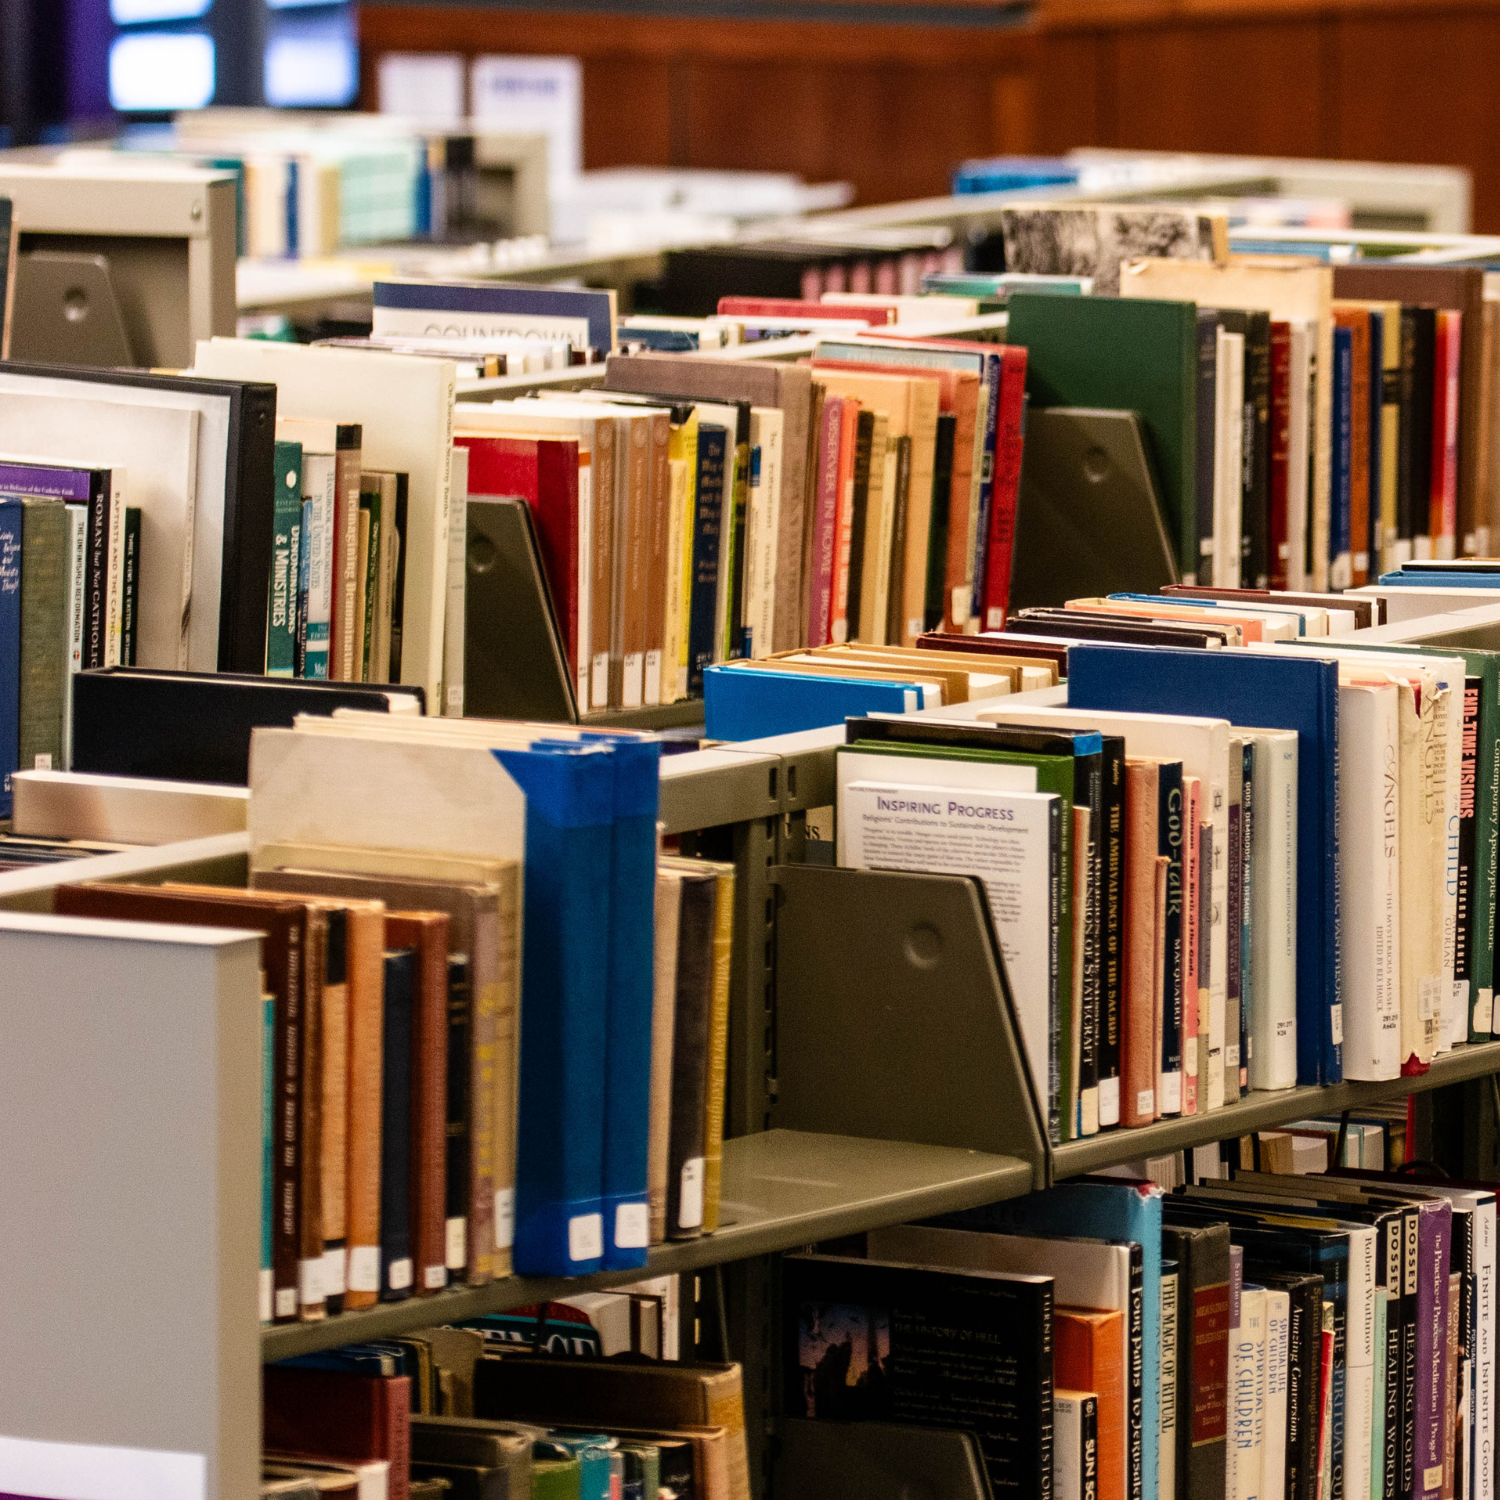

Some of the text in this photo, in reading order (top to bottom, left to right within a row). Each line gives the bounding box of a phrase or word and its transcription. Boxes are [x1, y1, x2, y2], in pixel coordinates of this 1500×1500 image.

[825, 407, 838, 494] OBSERVER
[112, 492, 120, 544] BAPTISTS
[325, 473, 334, 524] HANDBOOK
[824, 501, 833, 518] IN
[312, 560, 321, 589] STATES
[313, 525, 323, 557] UNITED
[820, 523, 832, 574] ROME
[90, 493, 104, 668] ROMAN but Not CATHOLIC
[273, 534, 289, 626] & MINISTRIES
[288, 525, 300, 633] DENOMINATIONS
[109, 595, 118, 655] CATHOLIC
[1460, 688, 1479, 819] END-TIME VISIONS
[877, 796, 1014, 821] INSPIRING PROGRESS
[1383, 744, 1398, 858] ANGELS
[1446, 815, 1459, 896] CHILD
[1487, 829, 1499, 898] Apocalyptic
[1085, 842, 1096, 1066] DIMENSION OF STATECRAFT
[1108, 804, 1120, 1045] THE AMBIVALENCE OF THE SACRED
[1456, 866, 1468, 973] RICHARD ABANES
[1487, 902, 1497, 951] Rhetoric
[1172, 938, 1181, 1029] MACQUARRIE
[1375, 969, 1383, 982] REX
[1376, 954, 1383, 966] BY
[1375, 984, 1383, 1012] HAUCK
[1390, 1225, 1399, 1297] DOSSEY
[1408, 1219, 1417, 1292] DOSSEY
[1432, 1250, 1443, 1295] Practice
[1364, 1237, 1372, 1356] Robert Wuthnow
[1432, 1306, 1441, 1349] Process
[1451, 1299, 1460, 1355] WOMEN
[1464, 1284, 1473, 1358] Parenting
[1482, 1264, 1490, 1321] FINITE
[1161, 1280, 1174, 1433] THE MAGIC OF RITUAL
[1268, 1319, 1278, 1394] OF CHILDREN
[1277, 1318, 1287, 1393] SPIRITUAL LIFE
[1290, 1304, 1303, 1443] Amazing Conversions
[1333, 1312, 1345, 1460] THE SPIRITUAL
[1431, 1351, 1440, 1412] Meditation
[1236, 1342, 1253, 1449] OF CHILDREN
[1386, 1328, 1399, 1498] HEALING WORDS
[1404, 1323, 1415, 1492] HEALING WORDS
[1481, 1361, 1490, 1434] INFINITE
[1429, 1422, 1439, 1462] Progoff
[1482, 1440, 1490, 1497] GOODS
